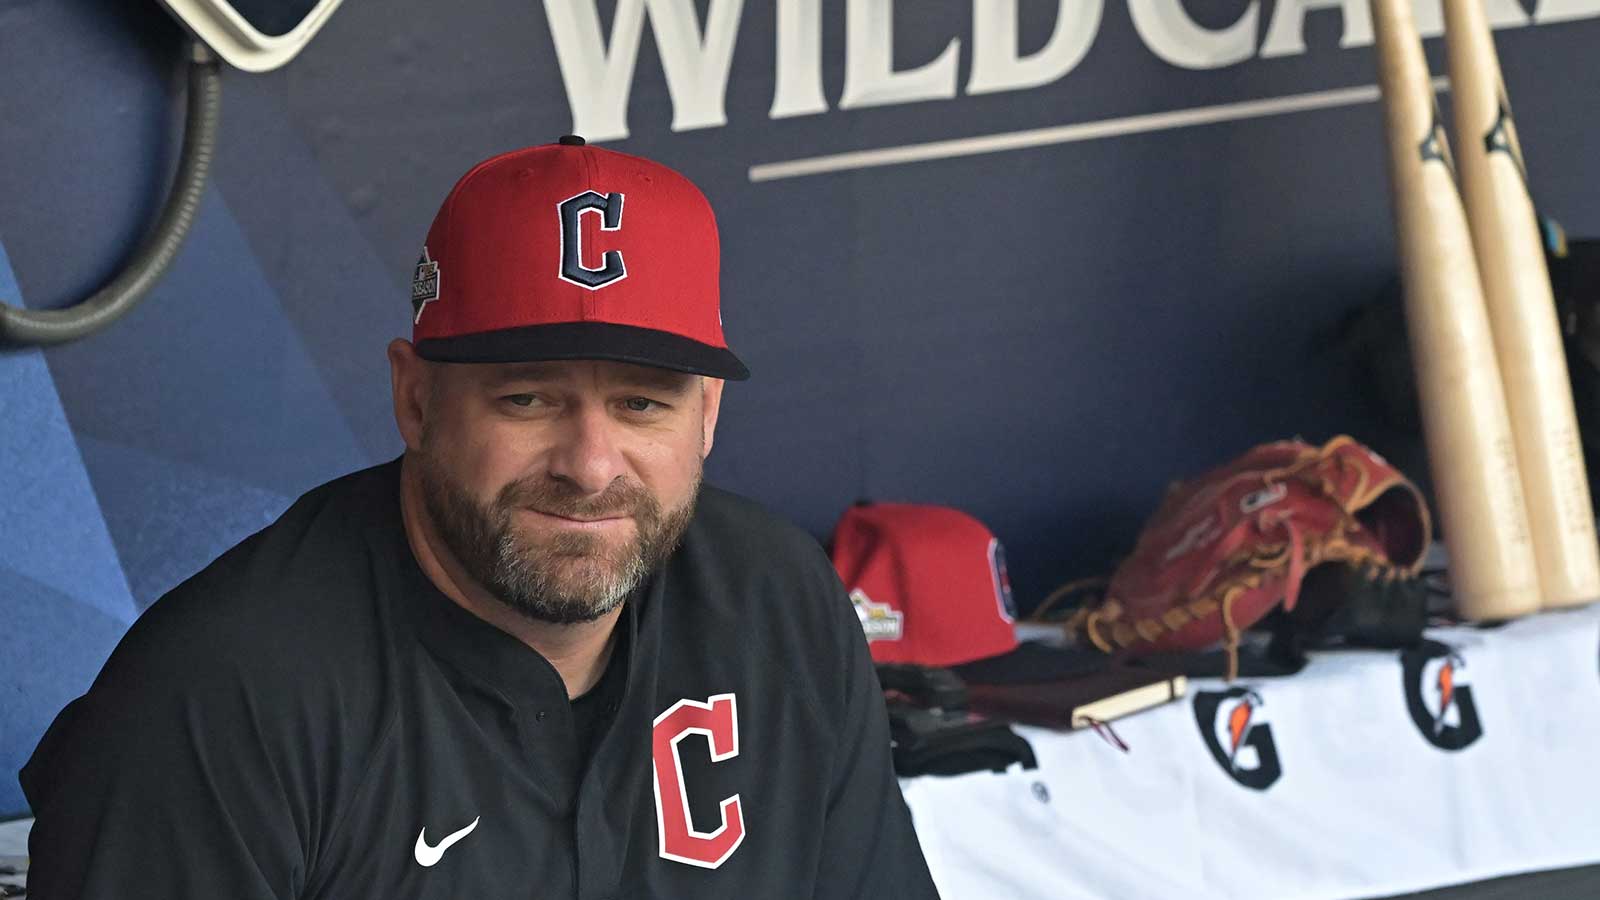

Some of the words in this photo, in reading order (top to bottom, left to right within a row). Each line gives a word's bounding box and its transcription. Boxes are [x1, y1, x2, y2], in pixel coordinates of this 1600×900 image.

[556, 189, 627, 290] C
[652, 693, 745, 869] C
[1193, 687, 1282, 790] G
